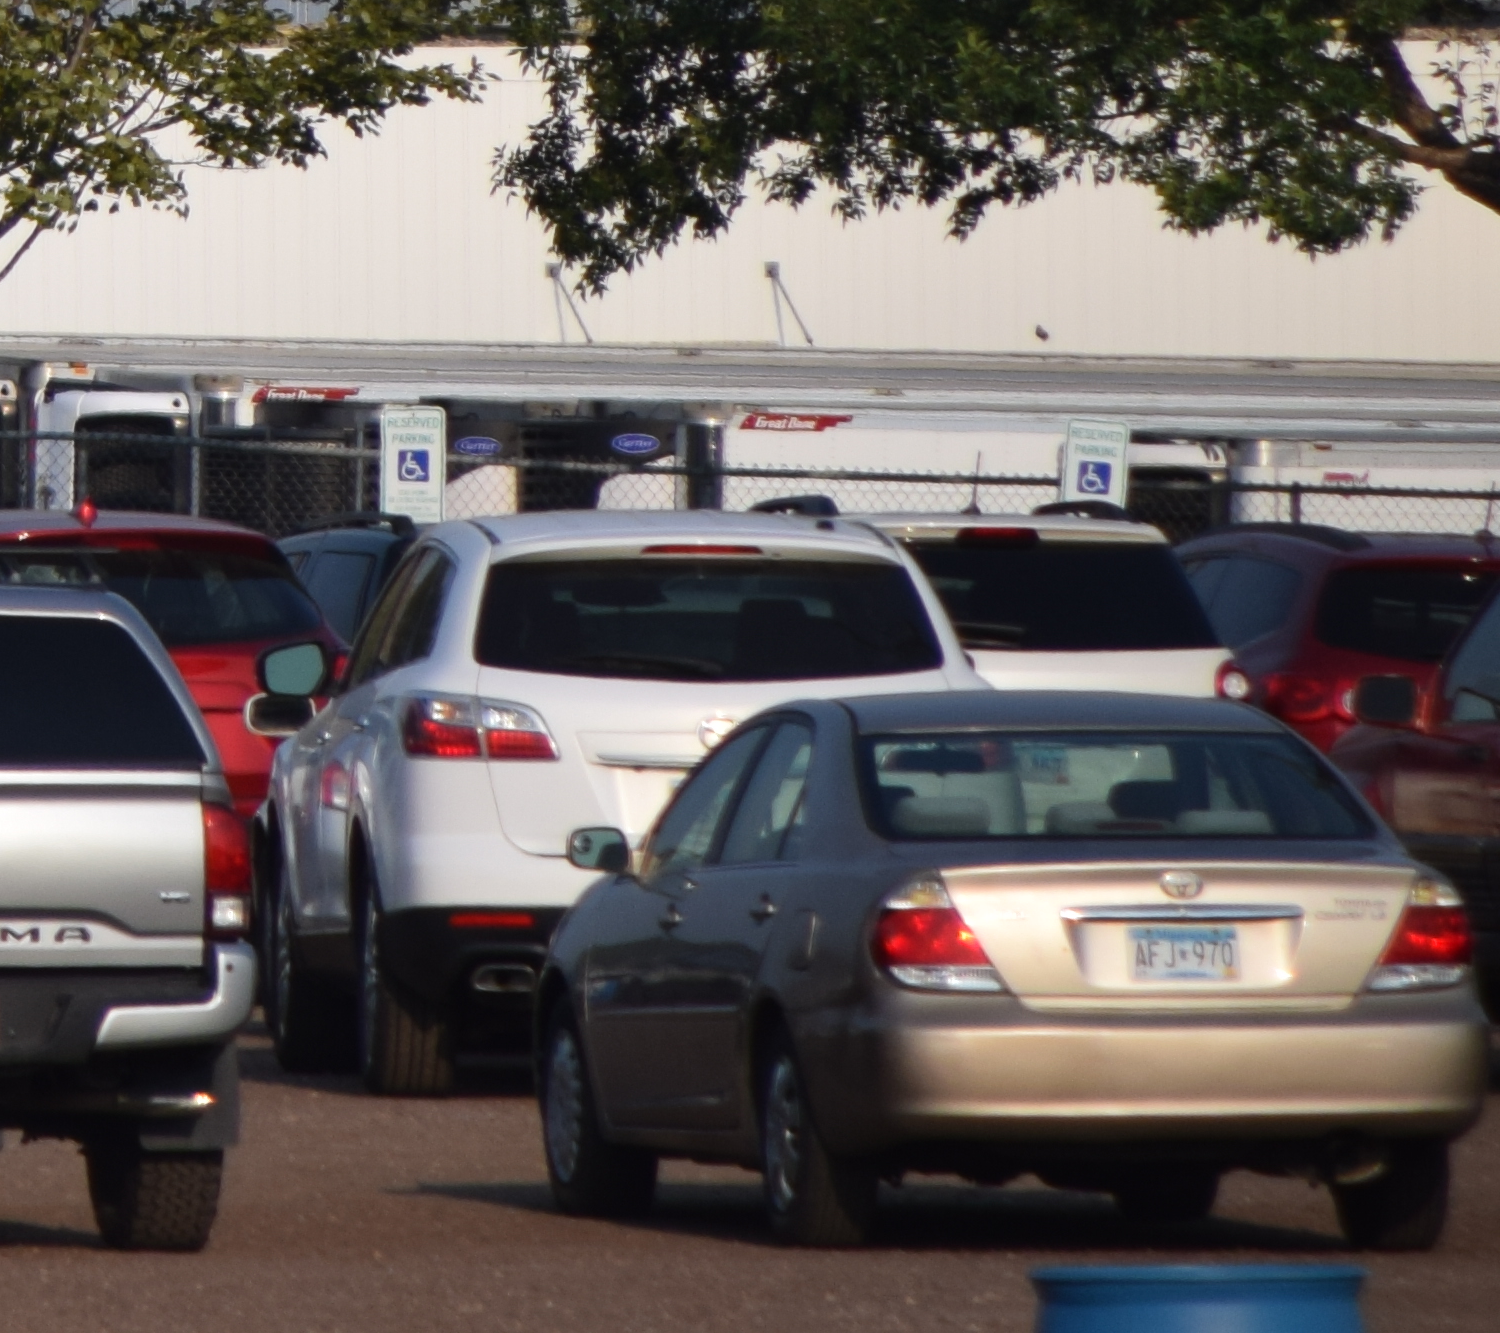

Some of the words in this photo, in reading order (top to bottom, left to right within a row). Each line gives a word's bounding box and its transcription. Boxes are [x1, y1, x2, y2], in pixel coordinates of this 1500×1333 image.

[387, 417, 440, 429] RESERVED
[392, 432, 434, 444] PARKING
[1136, 940, 1176, 968] AFJ
[1193, 940, 1232, 967] 970
